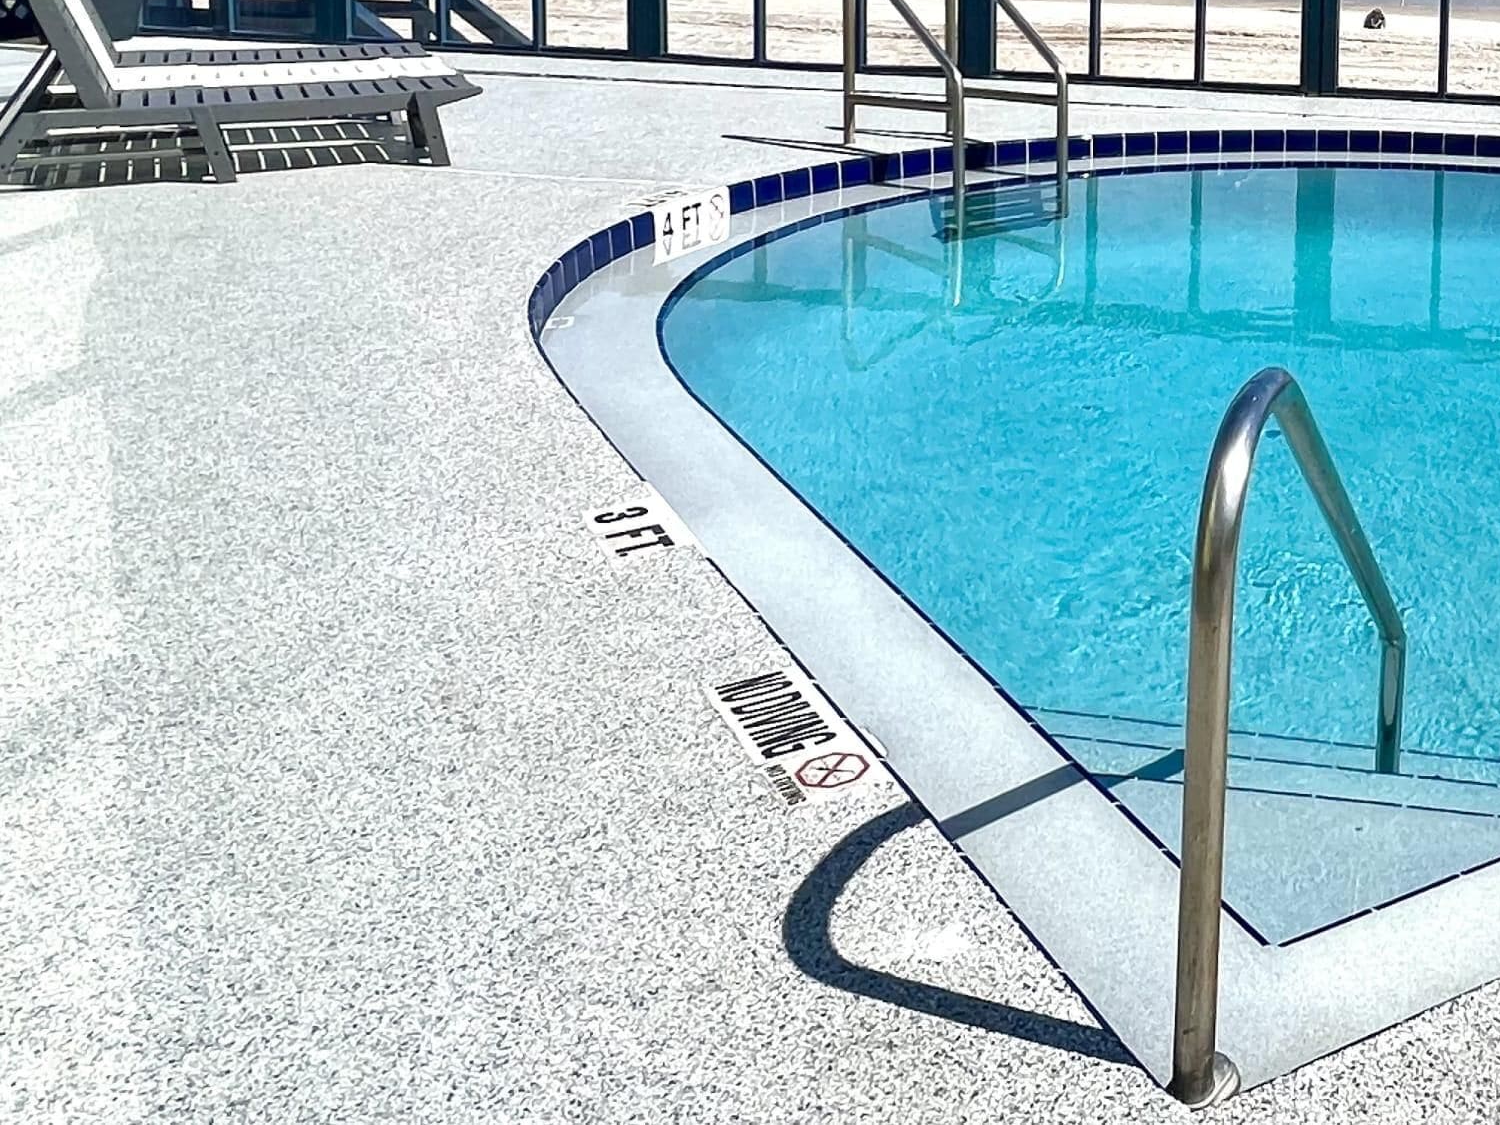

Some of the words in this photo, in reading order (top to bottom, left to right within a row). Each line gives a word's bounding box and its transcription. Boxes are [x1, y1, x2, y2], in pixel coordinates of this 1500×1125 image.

[663, 212, 674, 235] 4
[682, 203, 701, 230] FT
[594, 506, 648, 523] 3
[714, 671, 793, 702] NO
[730, 691, 837, 759] DIVING
